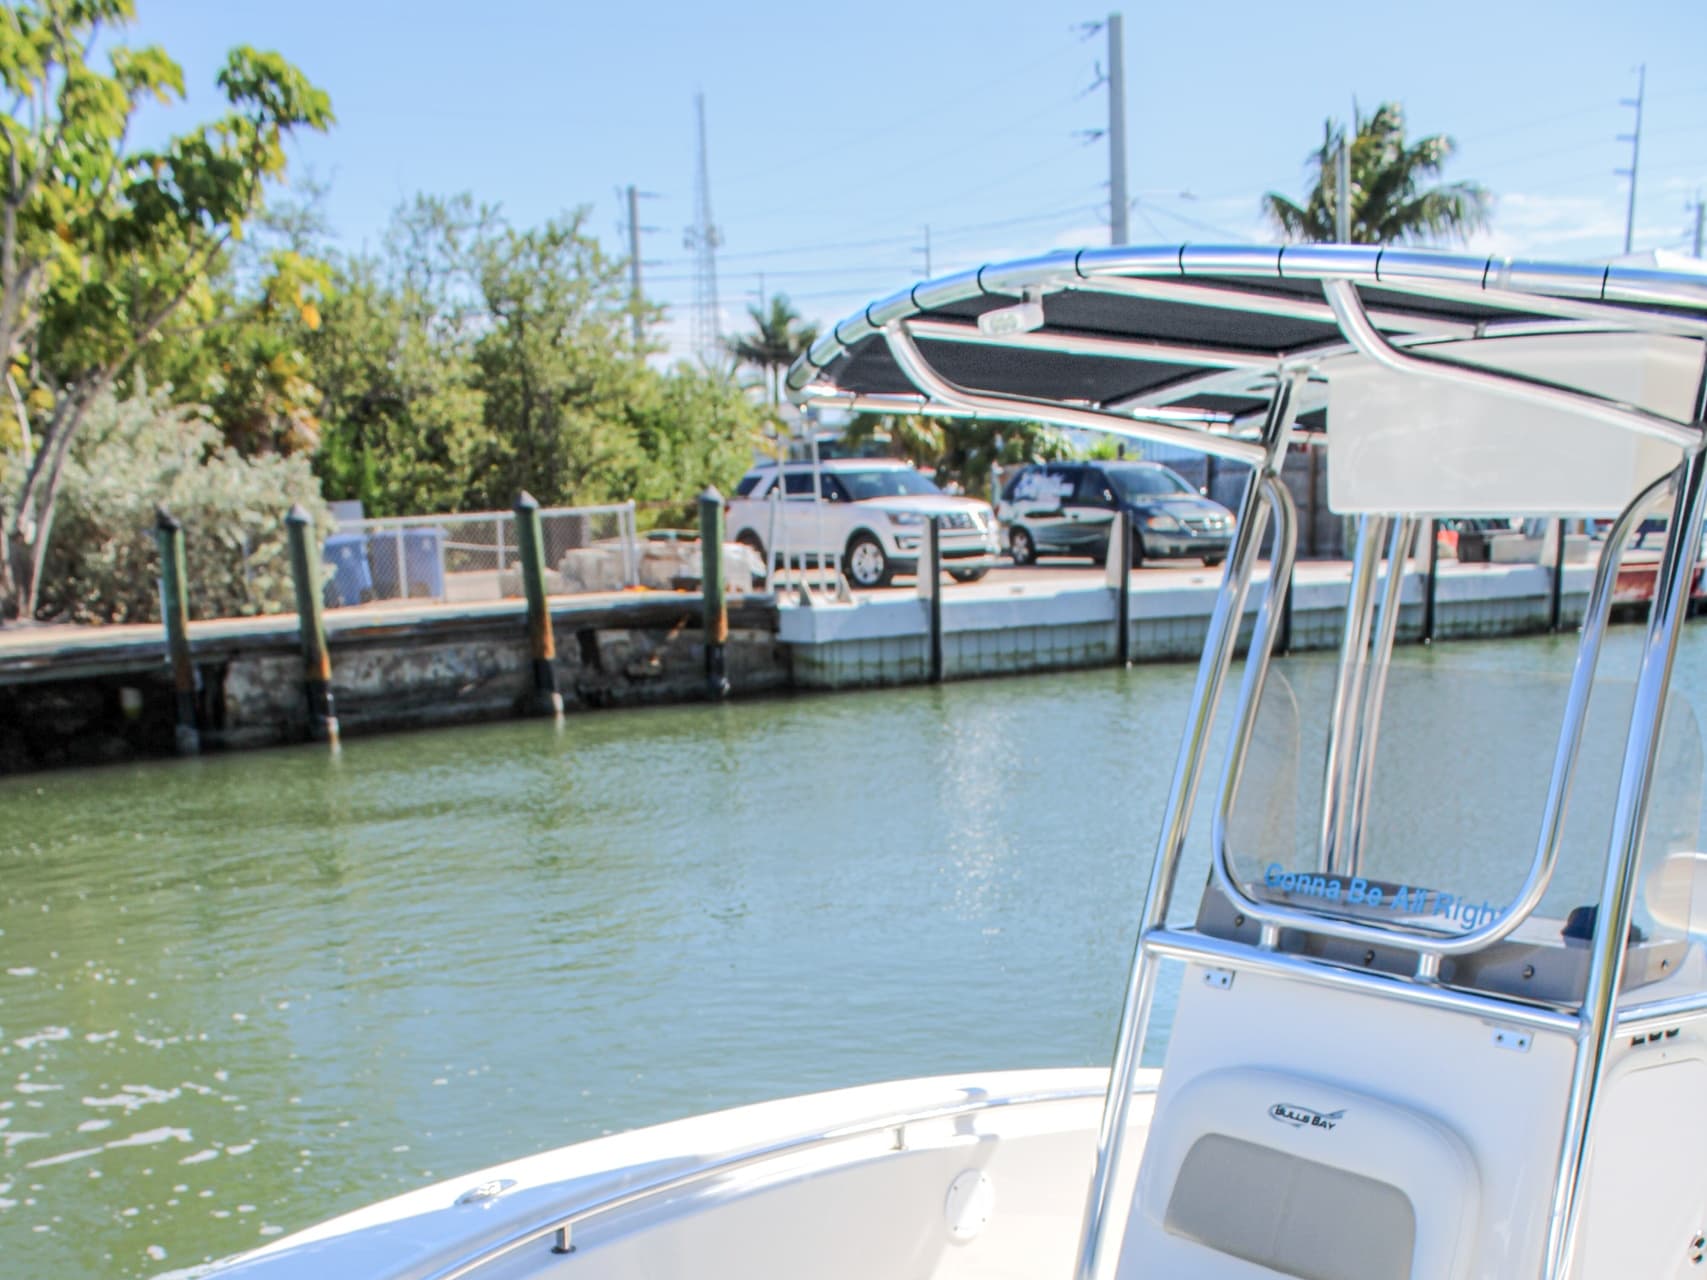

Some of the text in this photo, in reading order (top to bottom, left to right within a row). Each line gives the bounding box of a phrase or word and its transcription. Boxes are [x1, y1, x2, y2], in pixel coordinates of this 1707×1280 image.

[1264, 863, 1341, 899] Gonna
[1350, 877, 1383, 907] Be
[1390, 885, 1426, 913] All
